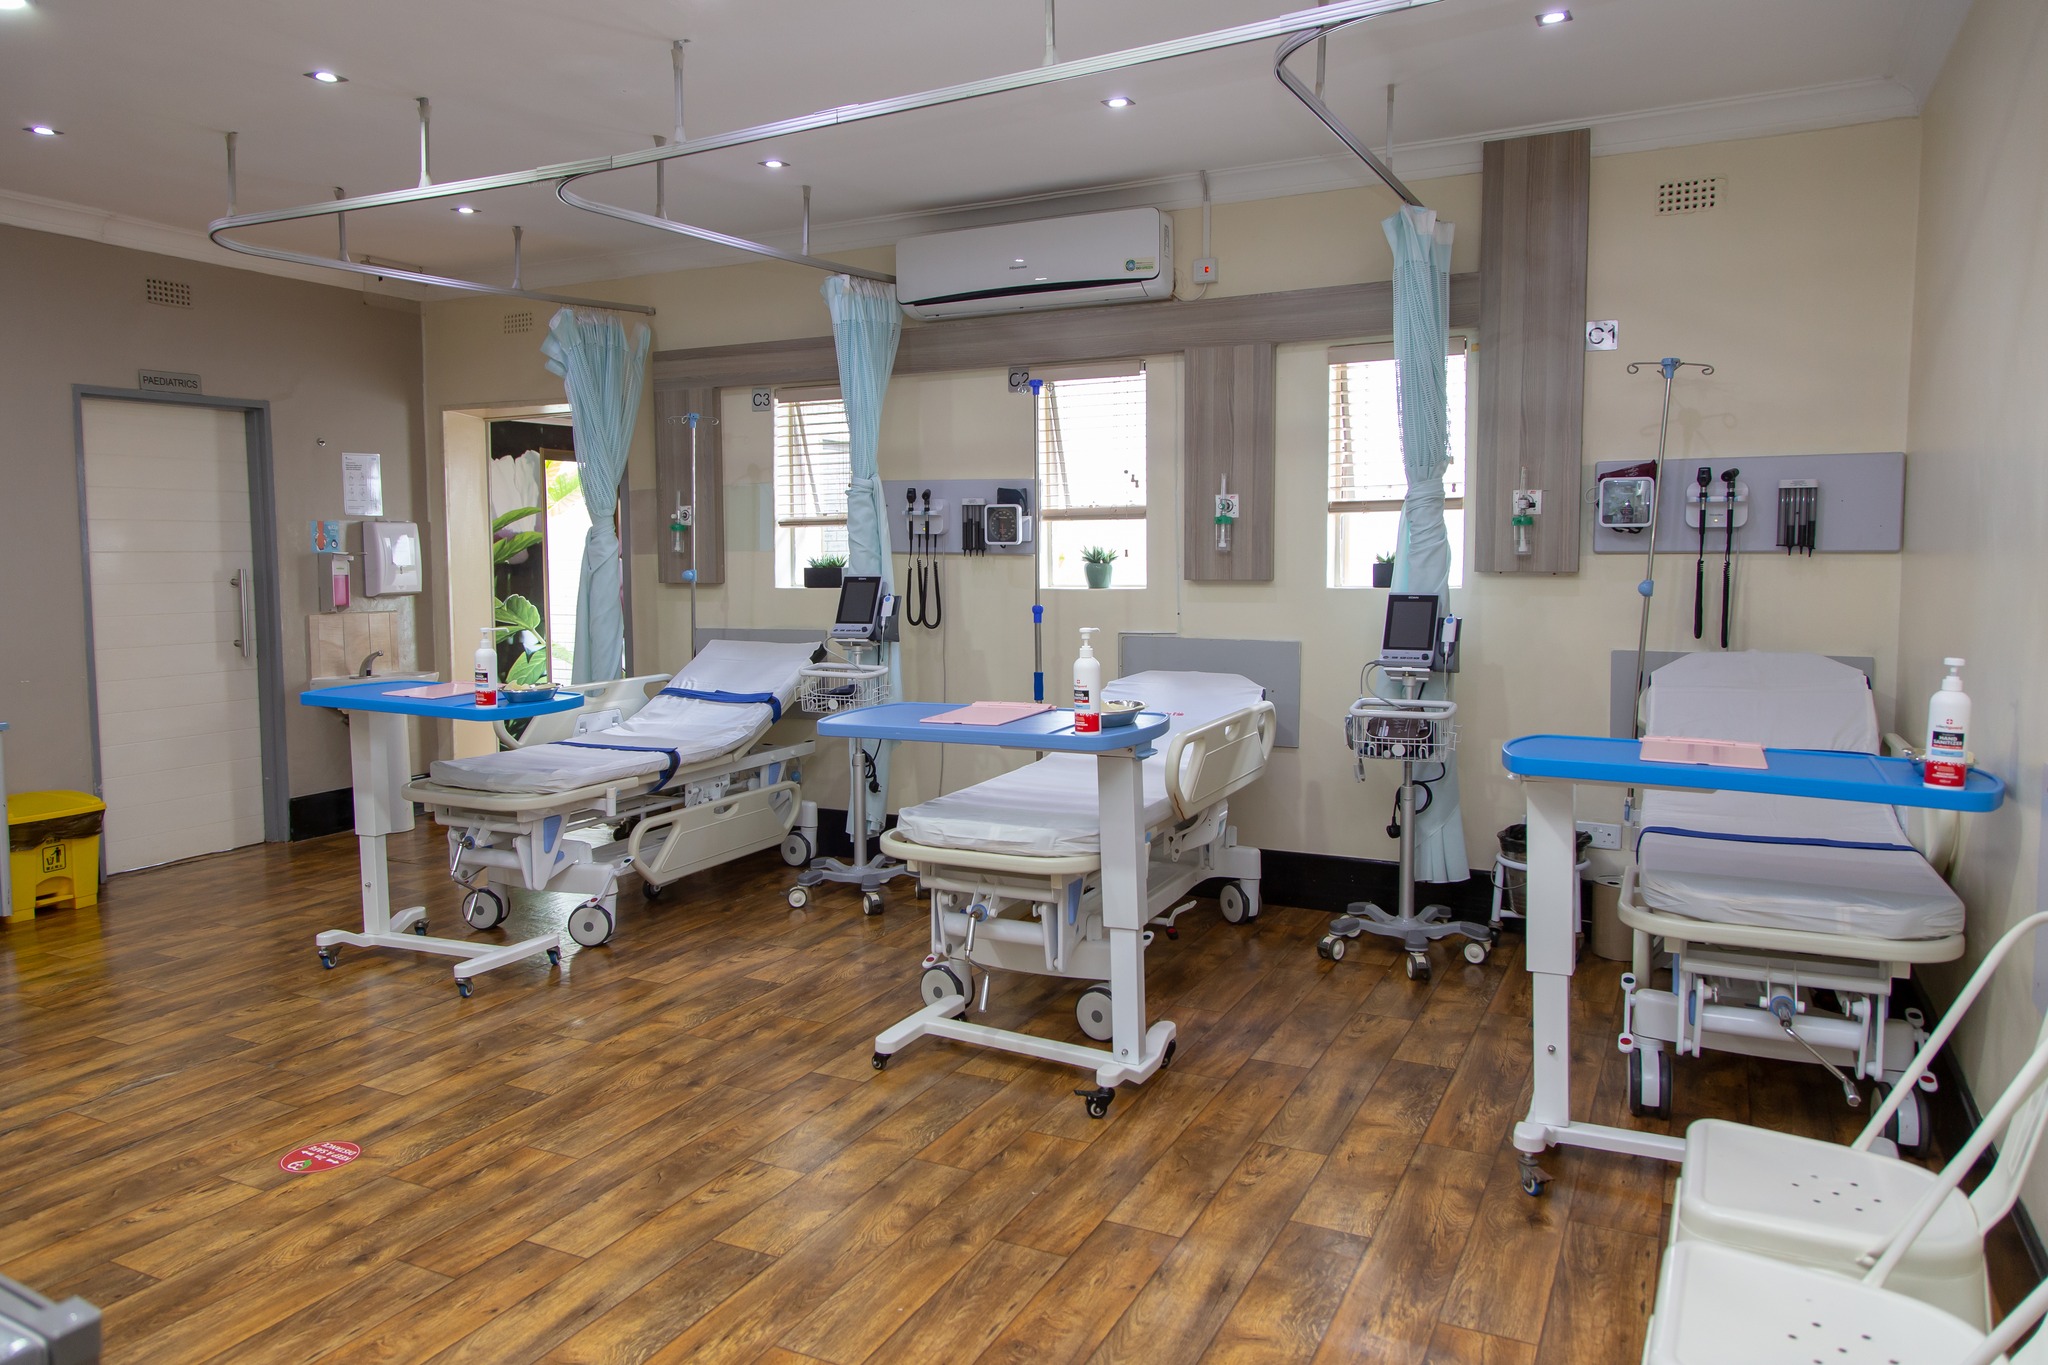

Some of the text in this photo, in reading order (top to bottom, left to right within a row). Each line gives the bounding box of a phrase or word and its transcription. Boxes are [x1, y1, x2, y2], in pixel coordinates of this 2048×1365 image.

[1589, 324, 1615, 345] C1
[143, 375, 198, 389] PAEDIATRICS
[1010, 372, 1029, 387] C2
[753, 393, 770, 406] C3
